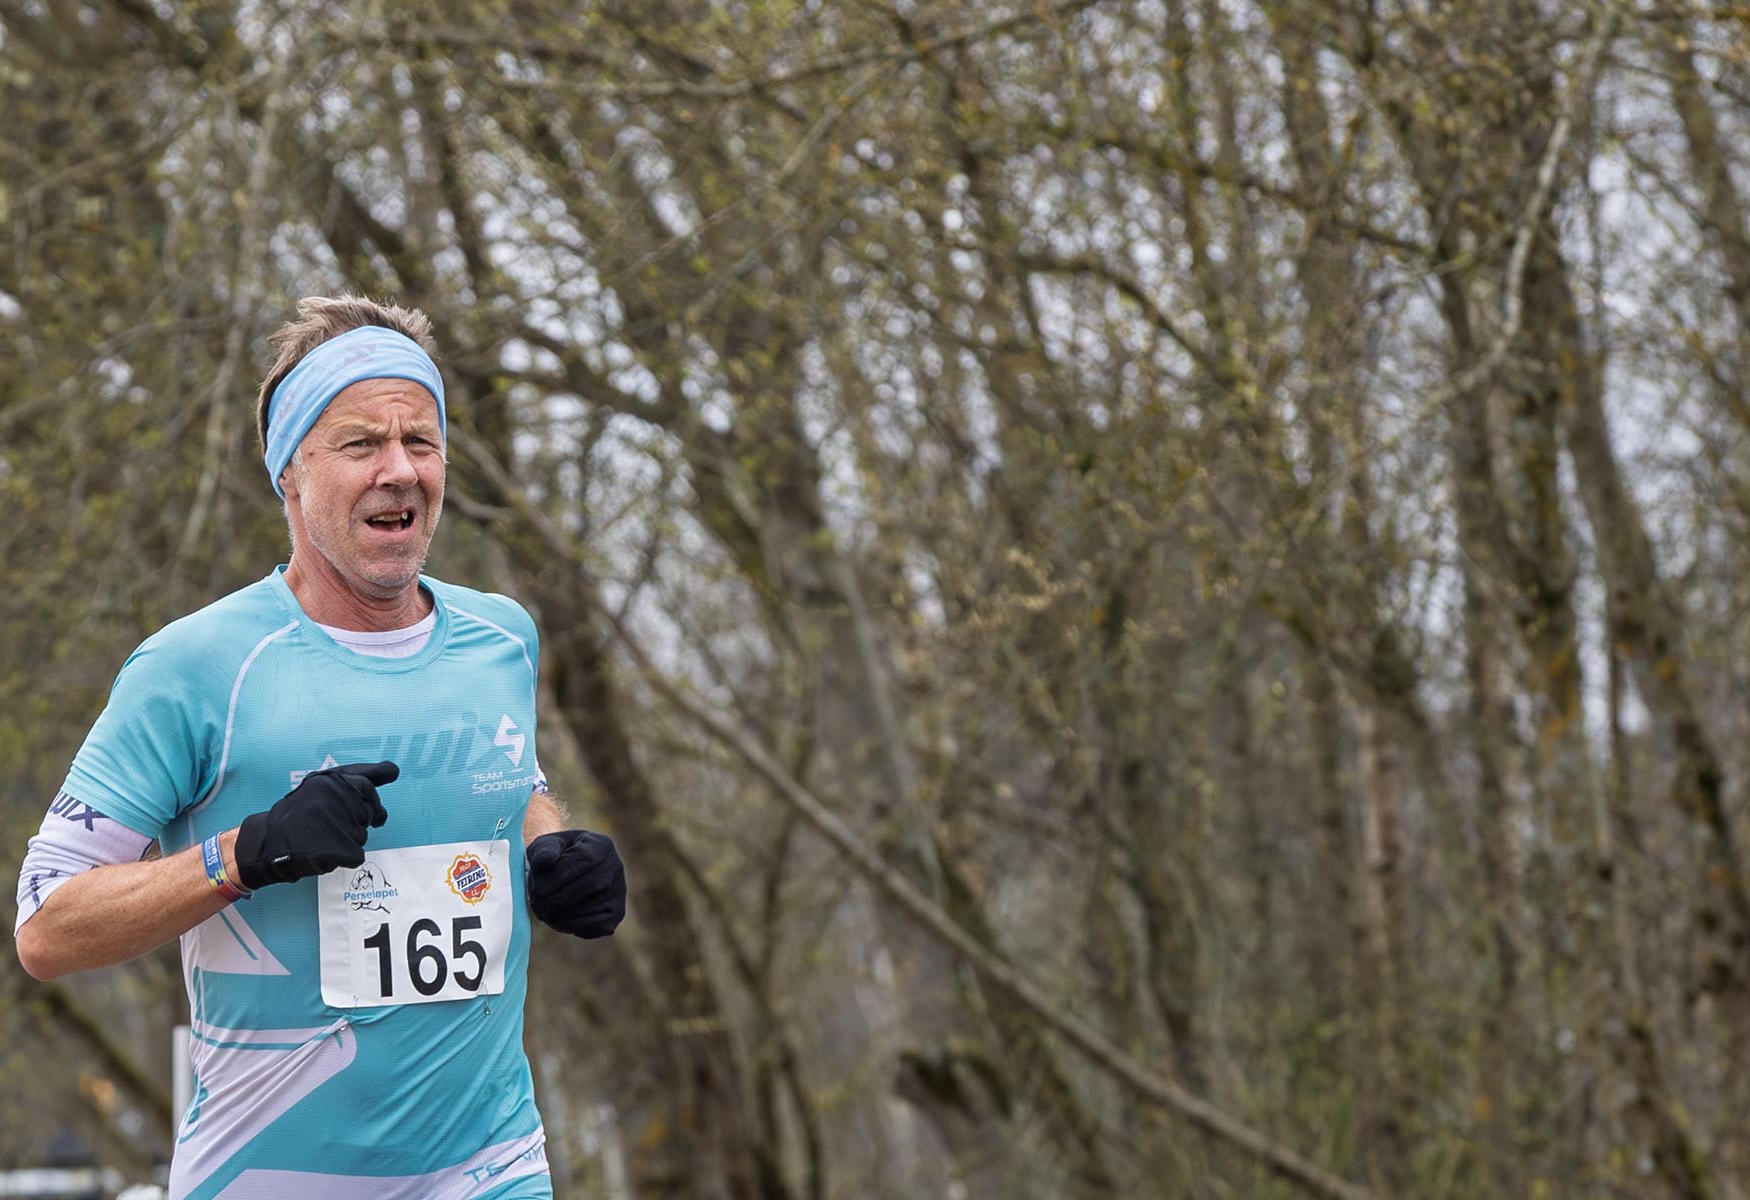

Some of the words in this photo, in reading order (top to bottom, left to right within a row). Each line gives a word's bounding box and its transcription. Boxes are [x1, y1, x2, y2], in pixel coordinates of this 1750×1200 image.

[456, 868, 486, 890] FEIRING
[343, 887, 399, 902] Perseløpet
[363, 915, 488, 998] 165
